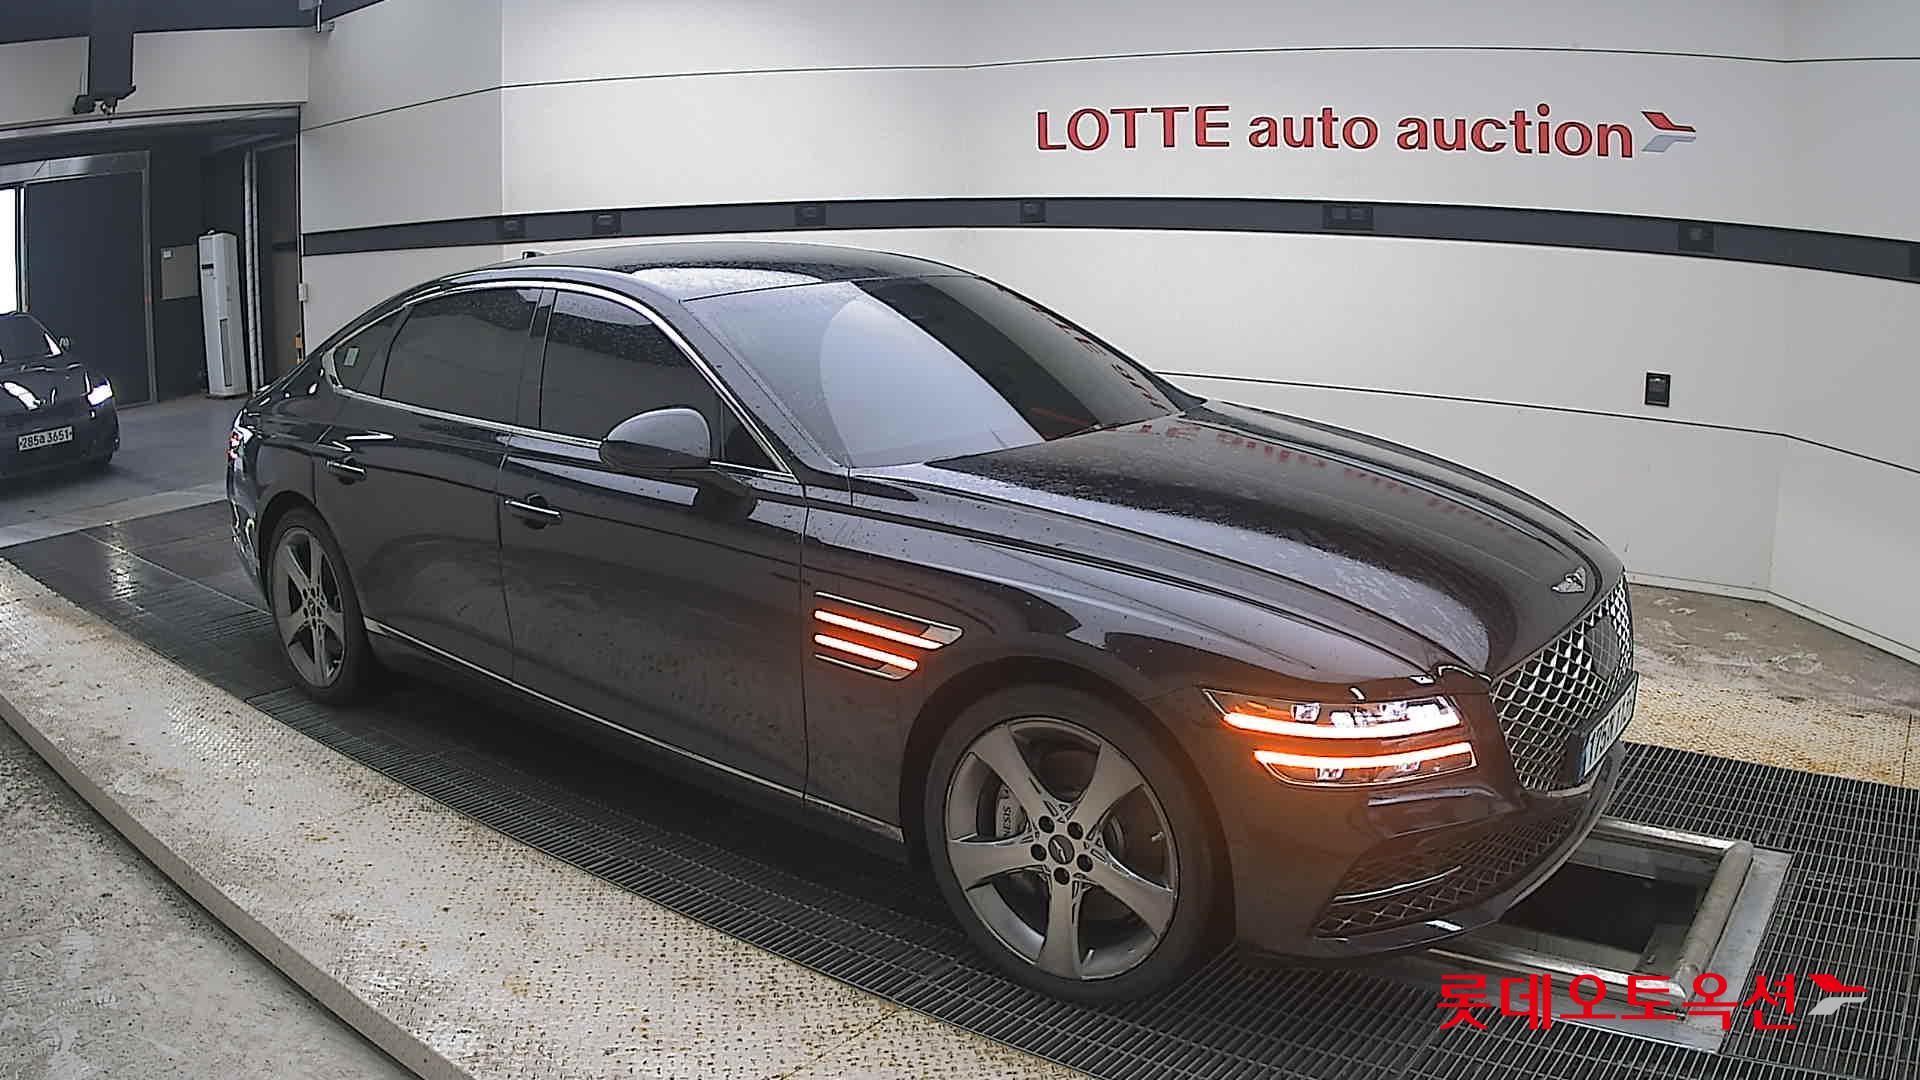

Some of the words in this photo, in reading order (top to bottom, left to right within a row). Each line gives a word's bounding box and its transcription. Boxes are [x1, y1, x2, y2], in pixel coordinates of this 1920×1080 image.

[1038, 106, 1228, 151] LOTTE
[1249, 108, 1378, 149] auto
[1398, 103, 1633, 158] auction
